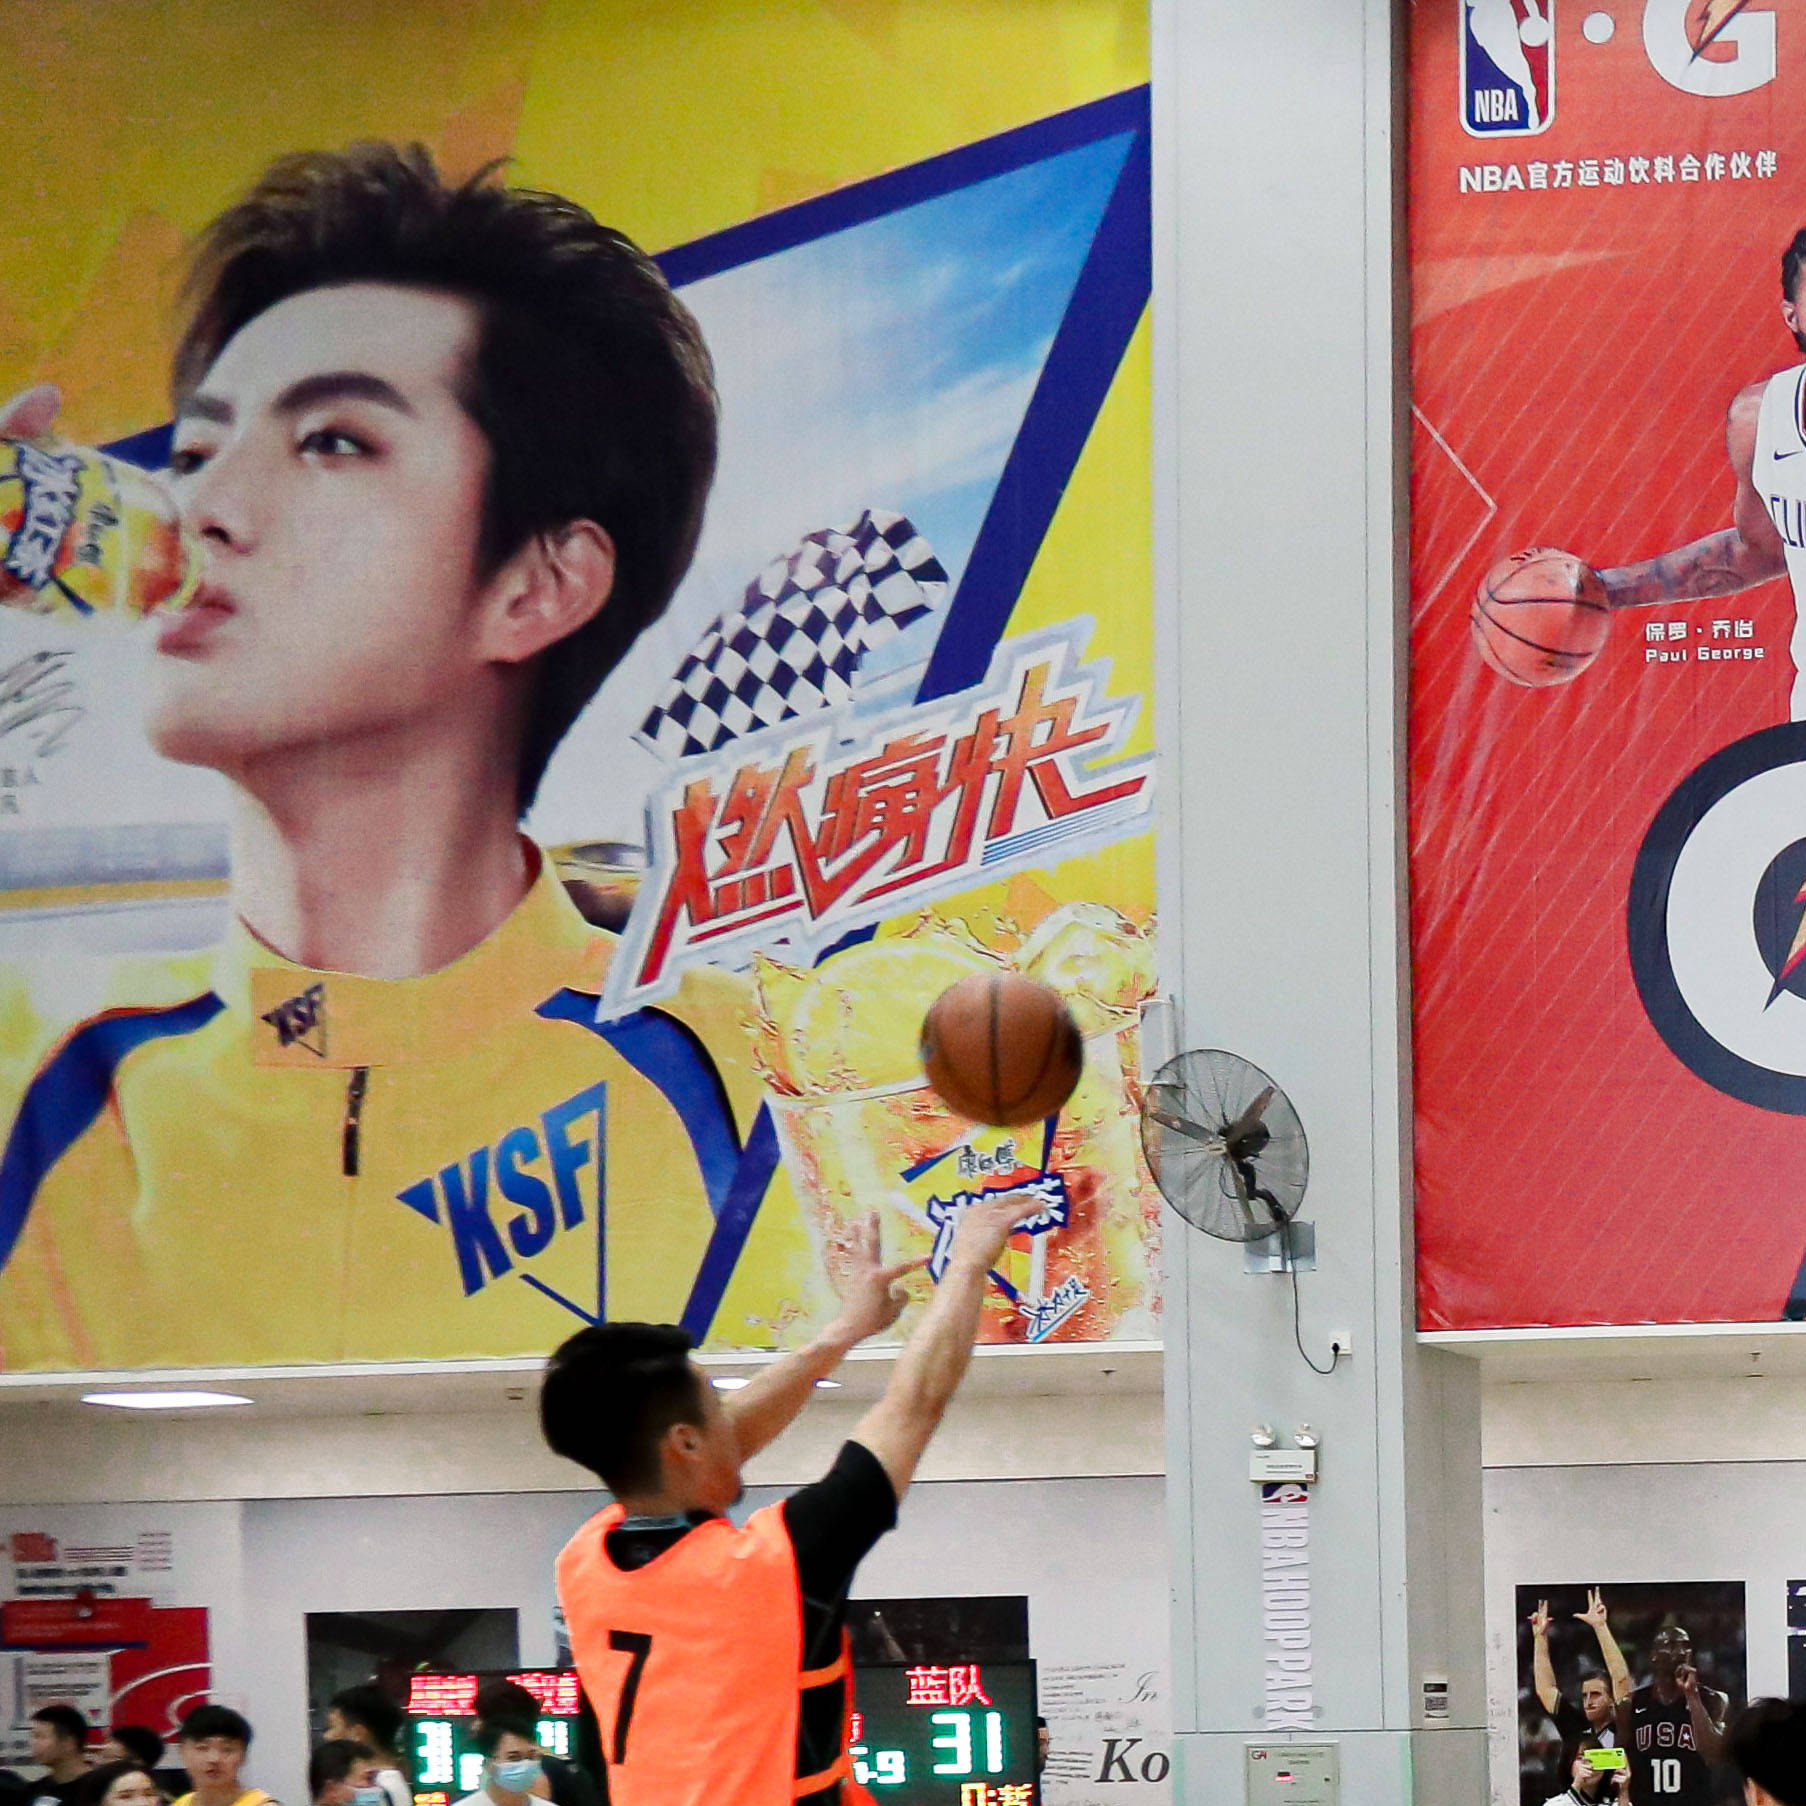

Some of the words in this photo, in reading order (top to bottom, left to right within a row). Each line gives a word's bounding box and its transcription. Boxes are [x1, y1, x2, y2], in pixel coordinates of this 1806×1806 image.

[1475, 88, 1518, 122] NBA
[1645, 648, 1688, 663] Paul
[1697, 645, 1765, 660] George
[428, 1082, 604, 1297] KSF
[608, 1630, 652, 1764] 7
[906, 1665, 993, 1706] 蓝队
[931, 1712, 1003, 1774] 31
[1635, 1720, 1698, 1752] USA
[1651, 1759, 1681, 1793] 10
